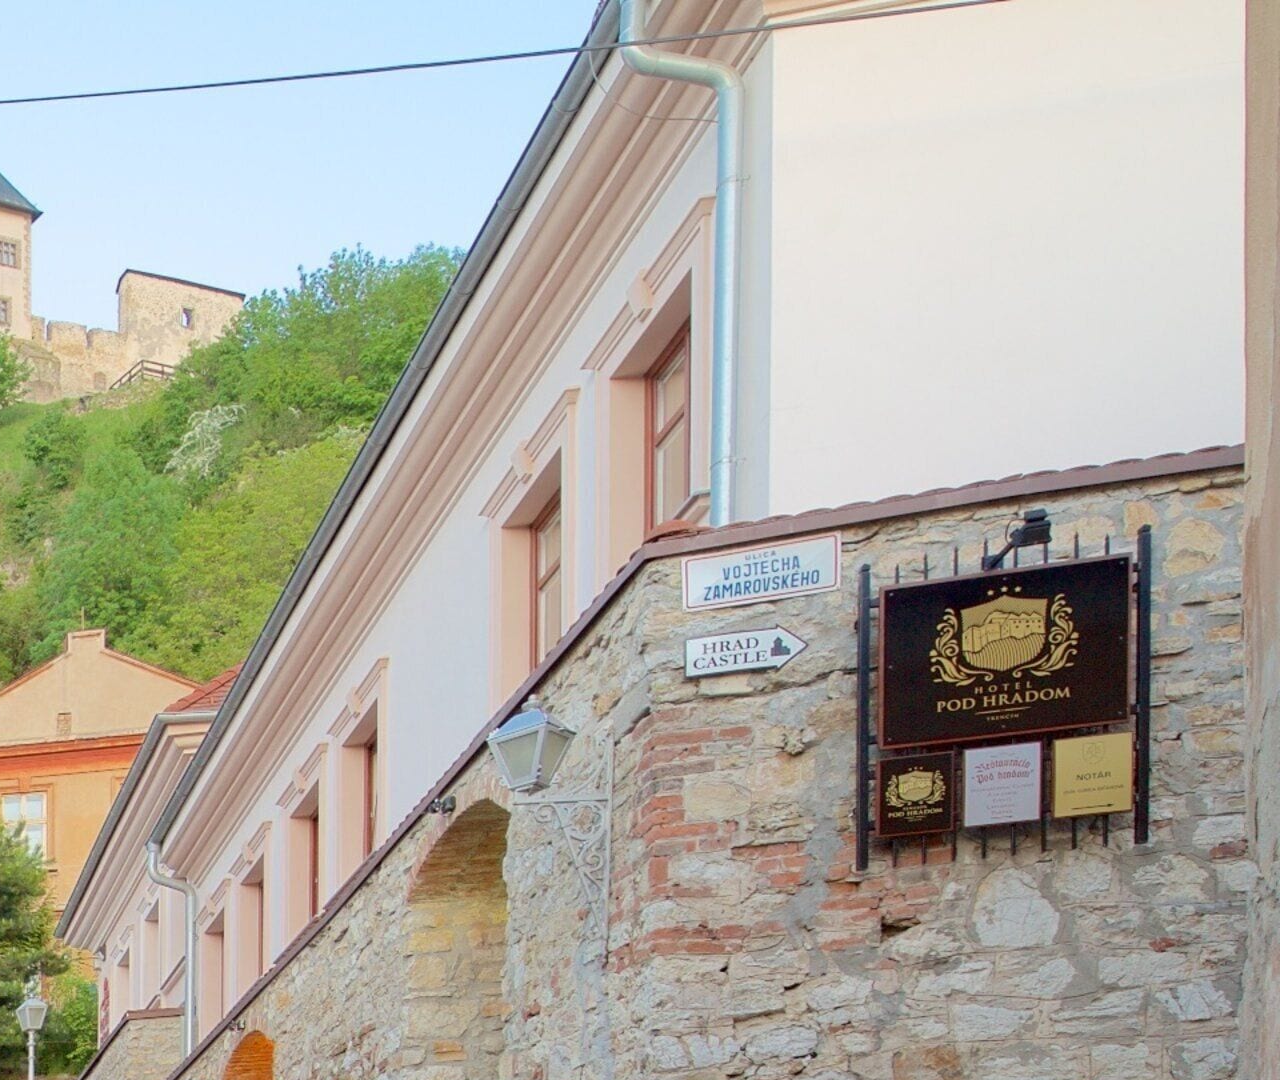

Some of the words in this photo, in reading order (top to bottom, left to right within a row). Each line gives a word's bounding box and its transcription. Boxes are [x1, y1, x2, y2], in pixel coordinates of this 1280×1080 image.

[744, 550, 777, 561] ULICA
[722, 555, 800, 581] VOJTECHA
[703, 569, 820, 601] ZAMAROVSKÉHO
[702, 637, 760, 655] HRAD
[693, 650, 768, 670] CASTLE
[974, 681, 1033, 695] HOTEL
[936, 698, 976, 713] POD
[983, 687, 1071, 708] HRADOM
